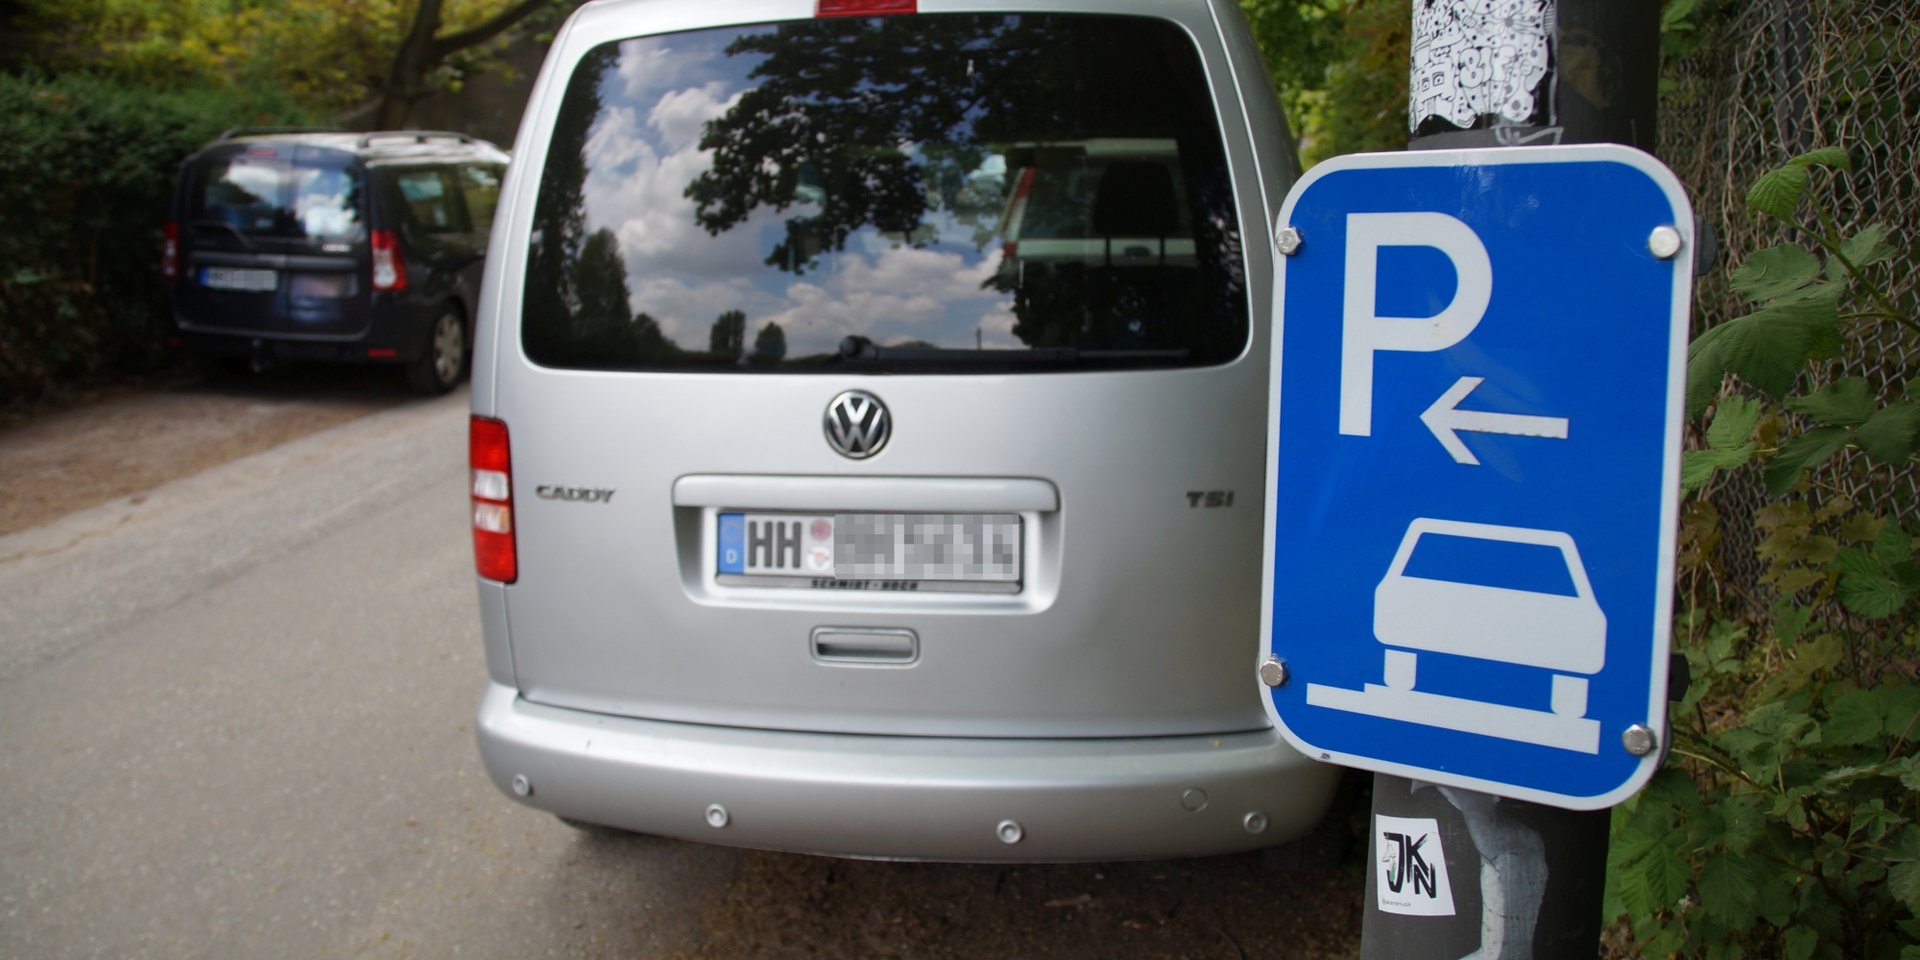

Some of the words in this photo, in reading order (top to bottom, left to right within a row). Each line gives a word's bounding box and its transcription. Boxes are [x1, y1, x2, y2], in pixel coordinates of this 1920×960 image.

[1339, 212, 1493, 436] P
[826, 392, 888, 457] VW
[535, 485, 615, 504] CADDY
[1186, 491, 1235, 509] TSI
[726, 548, 738, 564] D
[747, 520, 803, 568] HH
